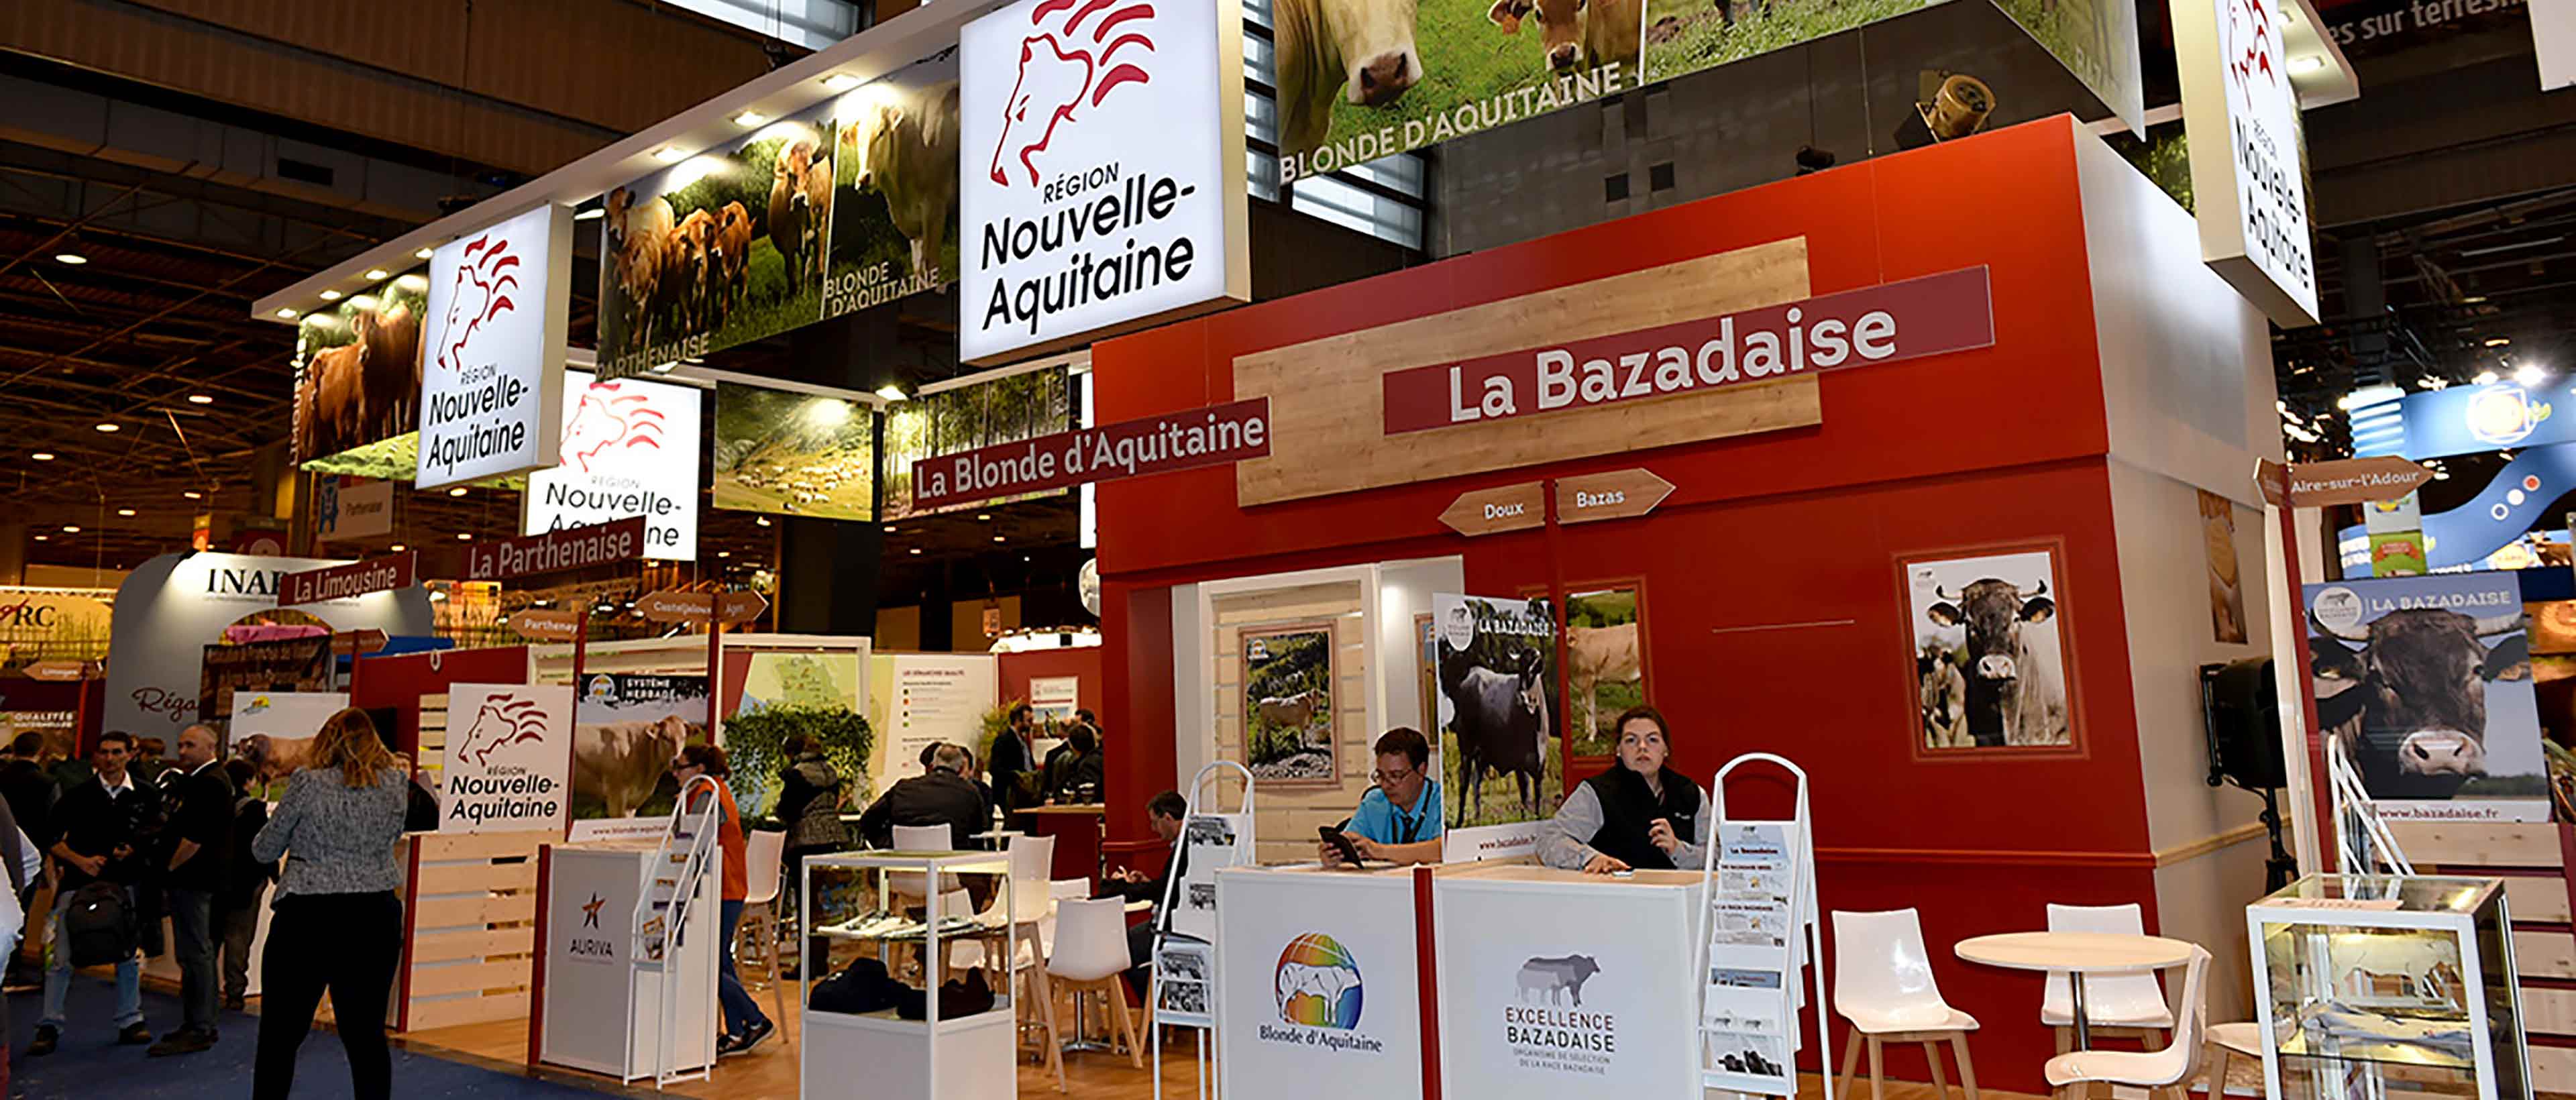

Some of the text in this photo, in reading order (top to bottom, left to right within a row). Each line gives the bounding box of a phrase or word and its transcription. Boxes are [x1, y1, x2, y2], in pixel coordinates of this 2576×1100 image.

[2361, 9, 2404, 40] sur
[1278, 62, 1622, 186] BLONDE D'AQUITAINE
[1043, 162, 1120, 203] RÉGION
[981, 174, 1195, 270] Nouvelle-
[2247, 184, 2309, 289] Aquitaine
[825, 261, 890, 299] BLONDE
[832, 267, 940, 317] D'AQUITAINE
[982, 237, 1194, 335] Aquitaine
[596, 331, 710, 380] PARTHENAISE
[1449, 307, 1898, 423] La Bazadaise
[428, 374, 529, 427] Nouvelle-
[427, 417, 525, 476] Aquitaine
[916, 413, 1265, 499] La Blonde d'Aquitaine
[545, 482, 682, 515] Nouvelle-
[2290, 472, 2420, 494] Aire-sur-l'Adour
[1484, 490, 1625, 519] Doux Bazas
[470, 547, 492, 580] La
[498, 527, 632, 575] Parthenaise
[293, 562, 397, 602] La Limousine
[2372, 590, 2512, 611] LA BAZADAISE
[450, 774, 559, 795] Nouvelle-
[449, 797, 557, 825] Aquitaine
[570, 938, 613, 956] AURIVA
[1259, 1026, 1383, 1052] Blonde d'Aquitaine
[1505, 1007, 1613, 1032] EXCELLENCE
[1507, 1026, 1615, 1052] BAZADAISE
